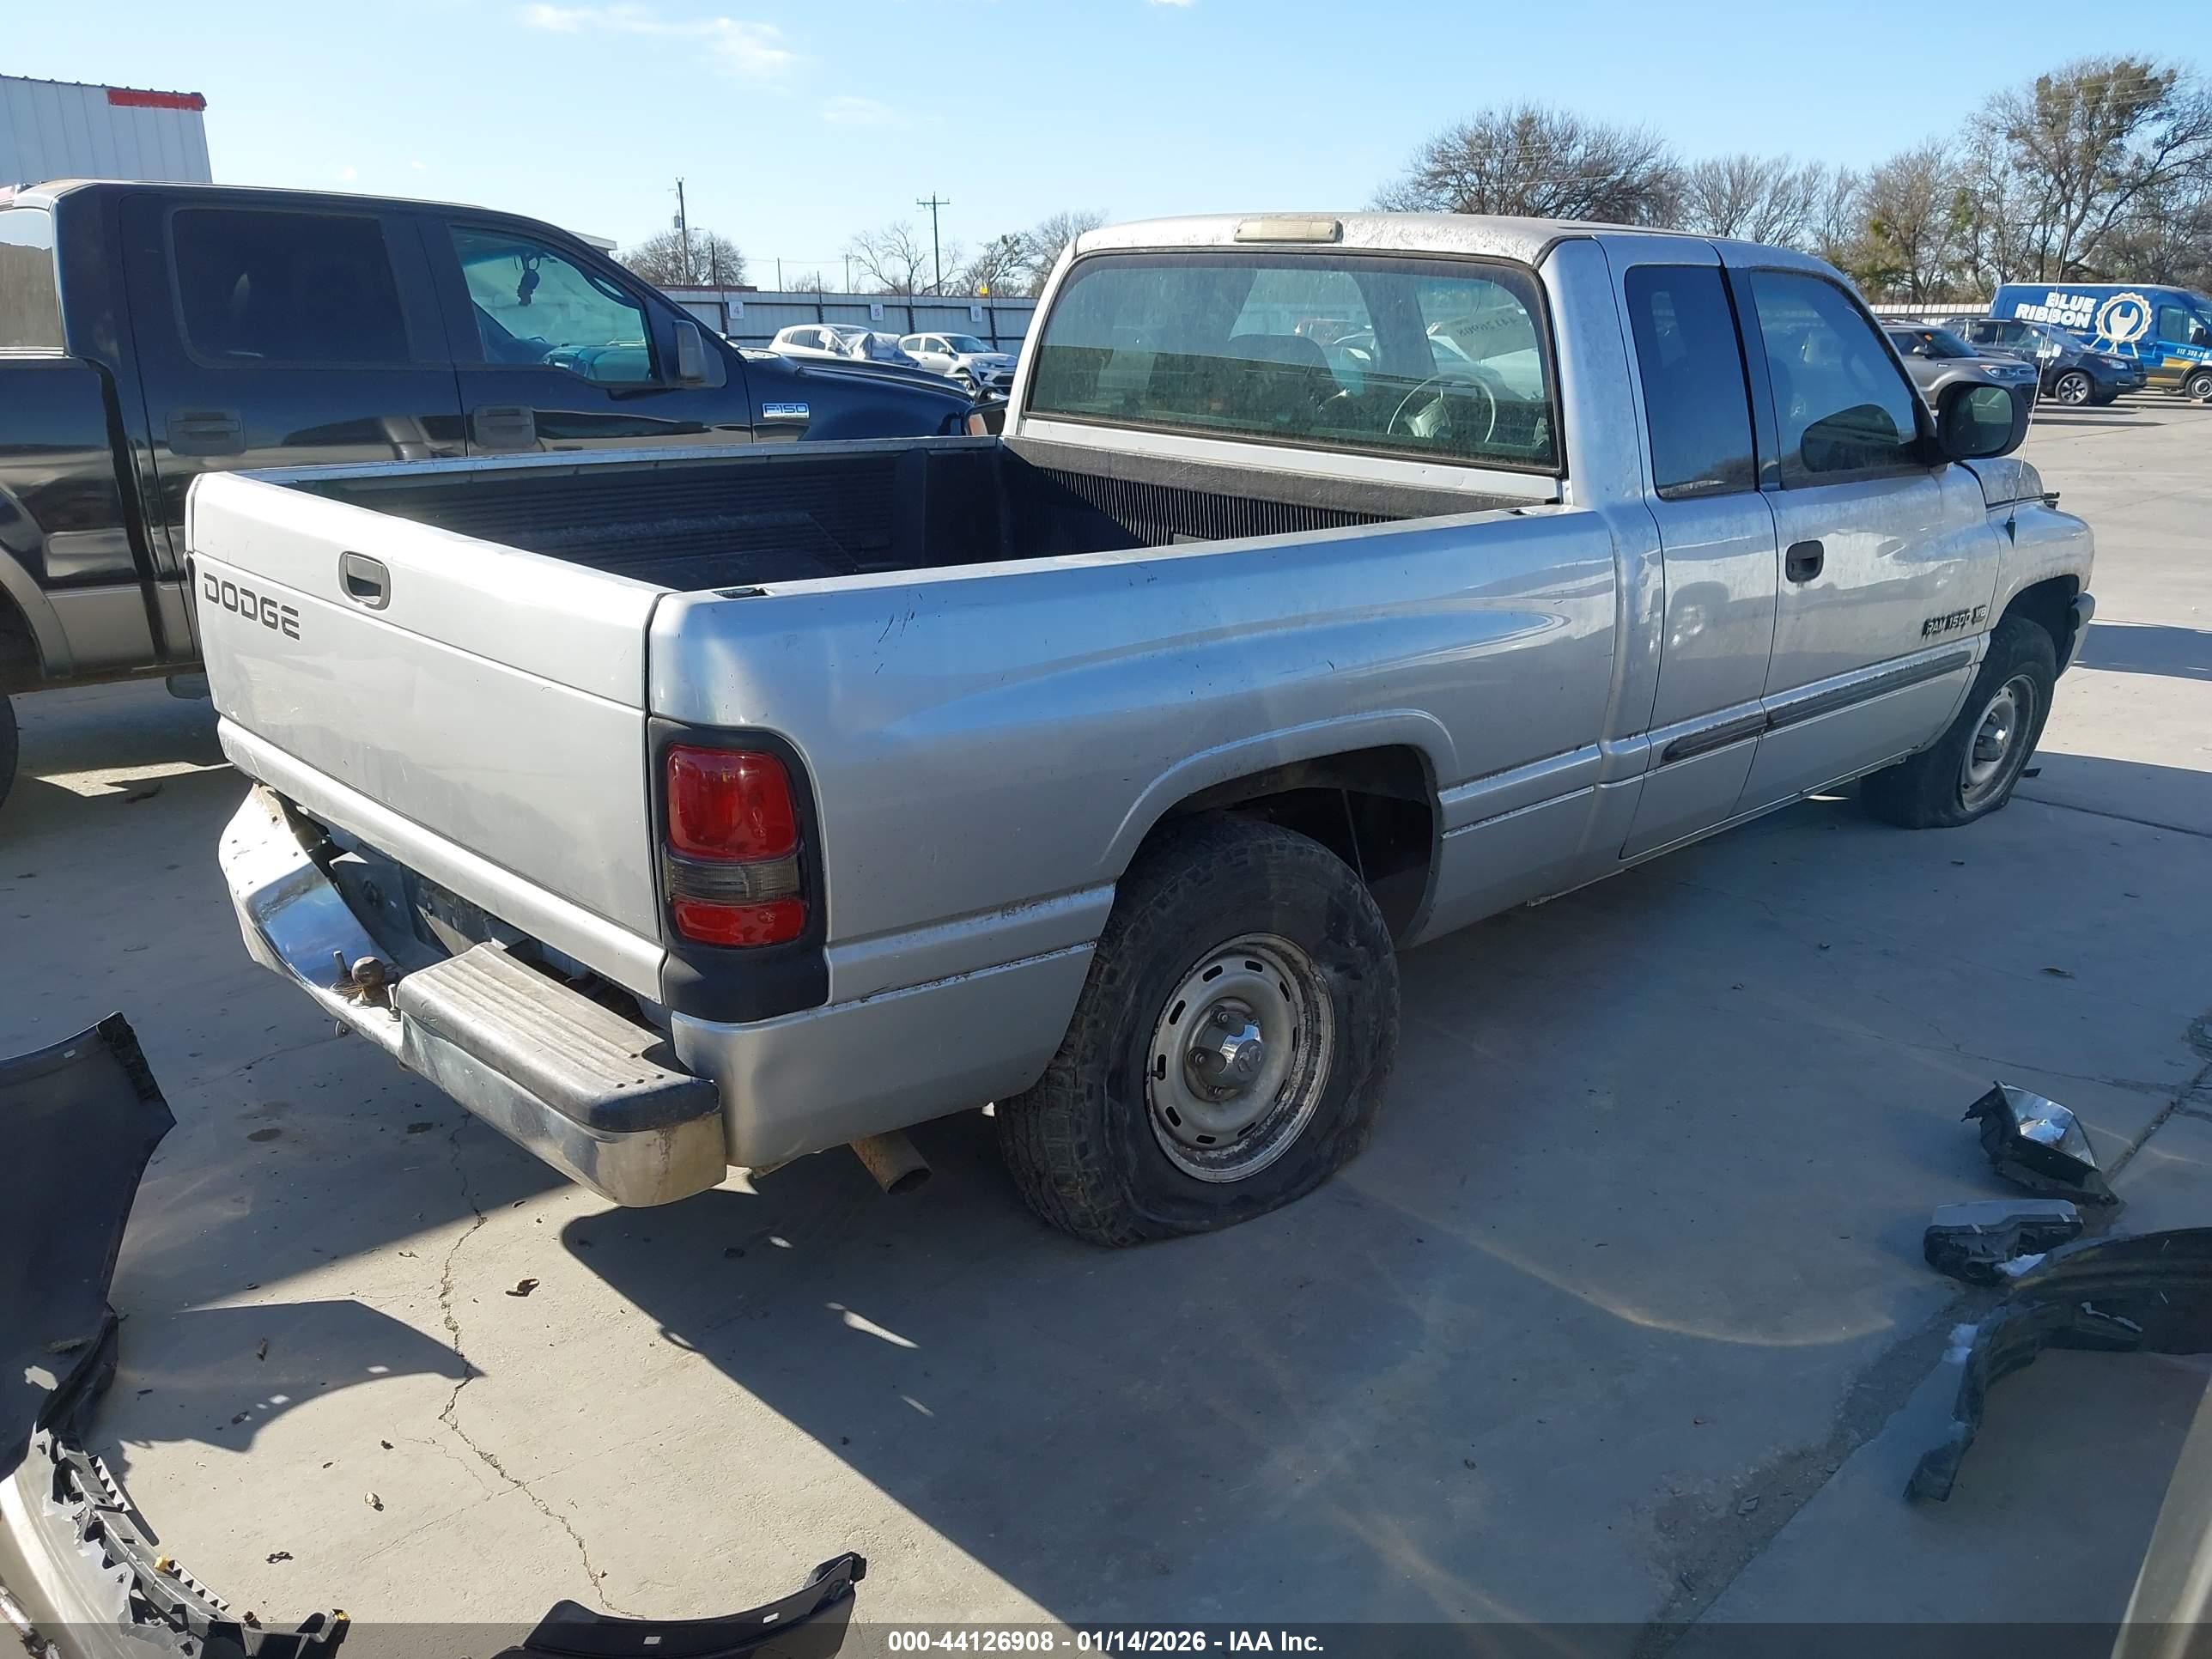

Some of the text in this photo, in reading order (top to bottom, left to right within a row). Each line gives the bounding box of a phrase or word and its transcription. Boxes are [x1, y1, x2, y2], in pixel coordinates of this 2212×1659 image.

[2045, 292, 2096, 313] BLUE
[2014, 303, 2092, 329] RIBBON
[204, 572, 300, 641] DODGE
[1924, 618, 1948, 635] RAM
[1948, 611, 1972, 629] 1500
